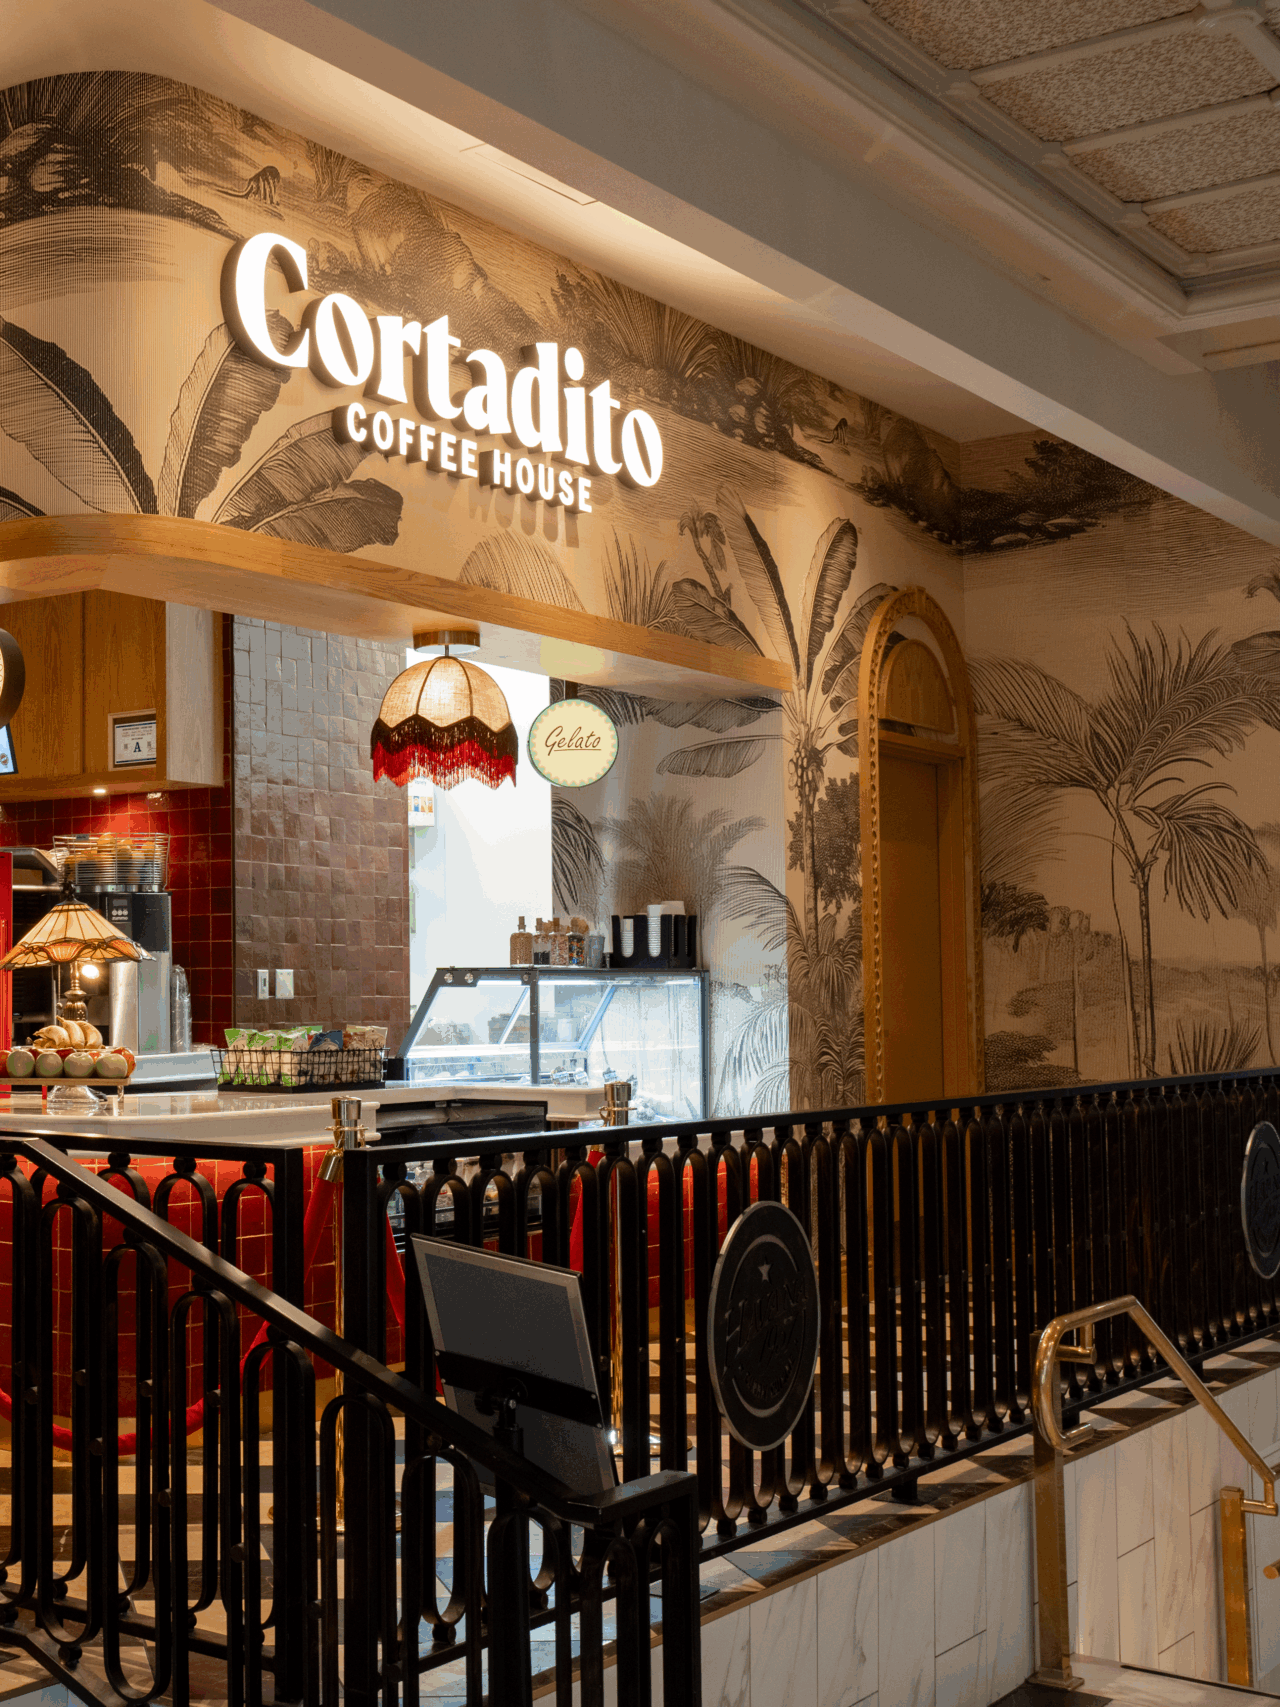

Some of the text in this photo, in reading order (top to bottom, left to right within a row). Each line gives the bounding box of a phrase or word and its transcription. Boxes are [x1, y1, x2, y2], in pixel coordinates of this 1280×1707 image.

[235, 232, 664, 487] Cortadito
[346, 402, 593, 513] COFFEE HOUSE
[133, 741, 142, 753] A
[544, 725, 602, 757] Gelato
